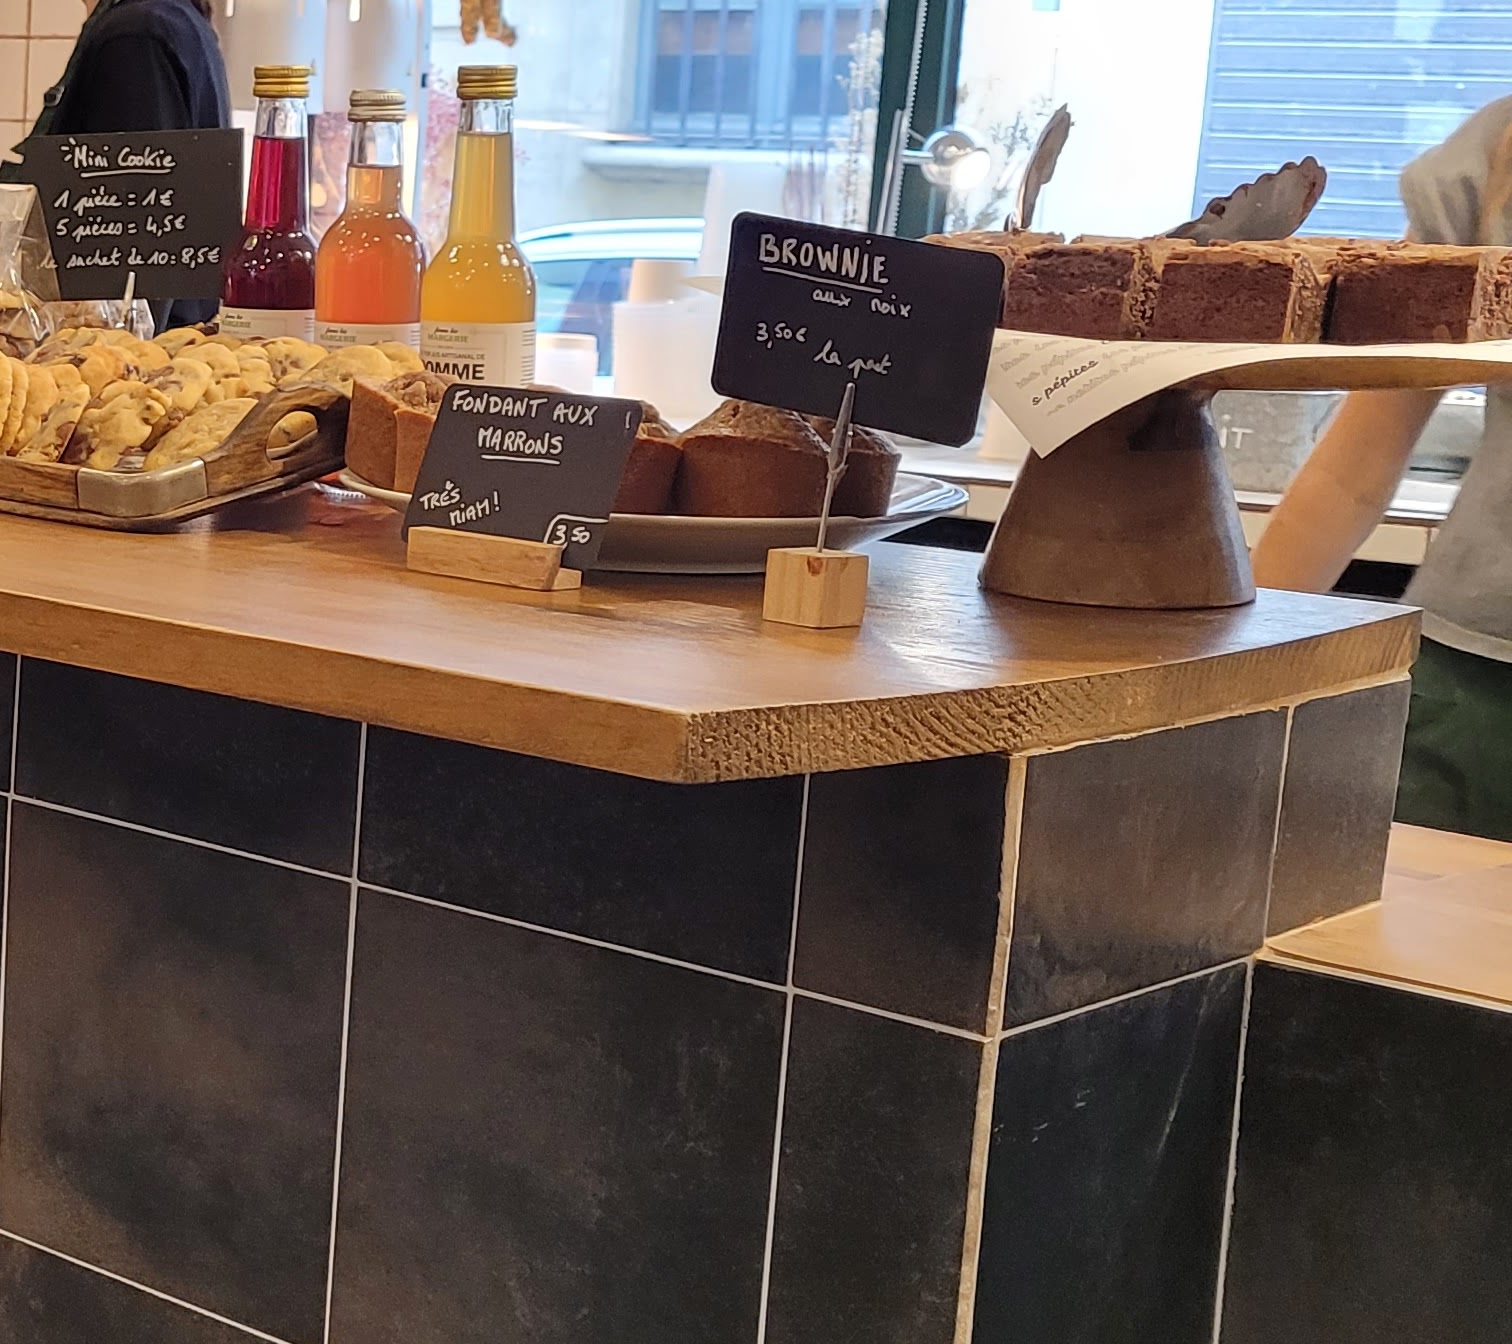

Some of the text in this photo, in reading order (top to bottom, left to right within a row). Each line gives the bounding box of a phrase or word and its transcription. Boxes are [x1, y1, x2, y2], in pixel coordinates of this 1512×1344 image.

[73, 144, 176, 168] Mini Cookie
[54, 189, 70, 207] 1
[56, 218, 70, 235] 5
[145, 215, 186, 237] 4,5€
[66, 247, 122, 268] sachet
[127, 247, 144, 265] de
[181, 247, 220, 269] 8,5€
[759, 233, 889, 284] BROWNIE
[812, 288, 912, 318] aux noix
[755, 322, 807, 349] 3,50€
[813, 339, 892, 379] la part
[451, 389, 598, 426] FONDANT AUX
[477, 426, 564, 455] MARRONS
